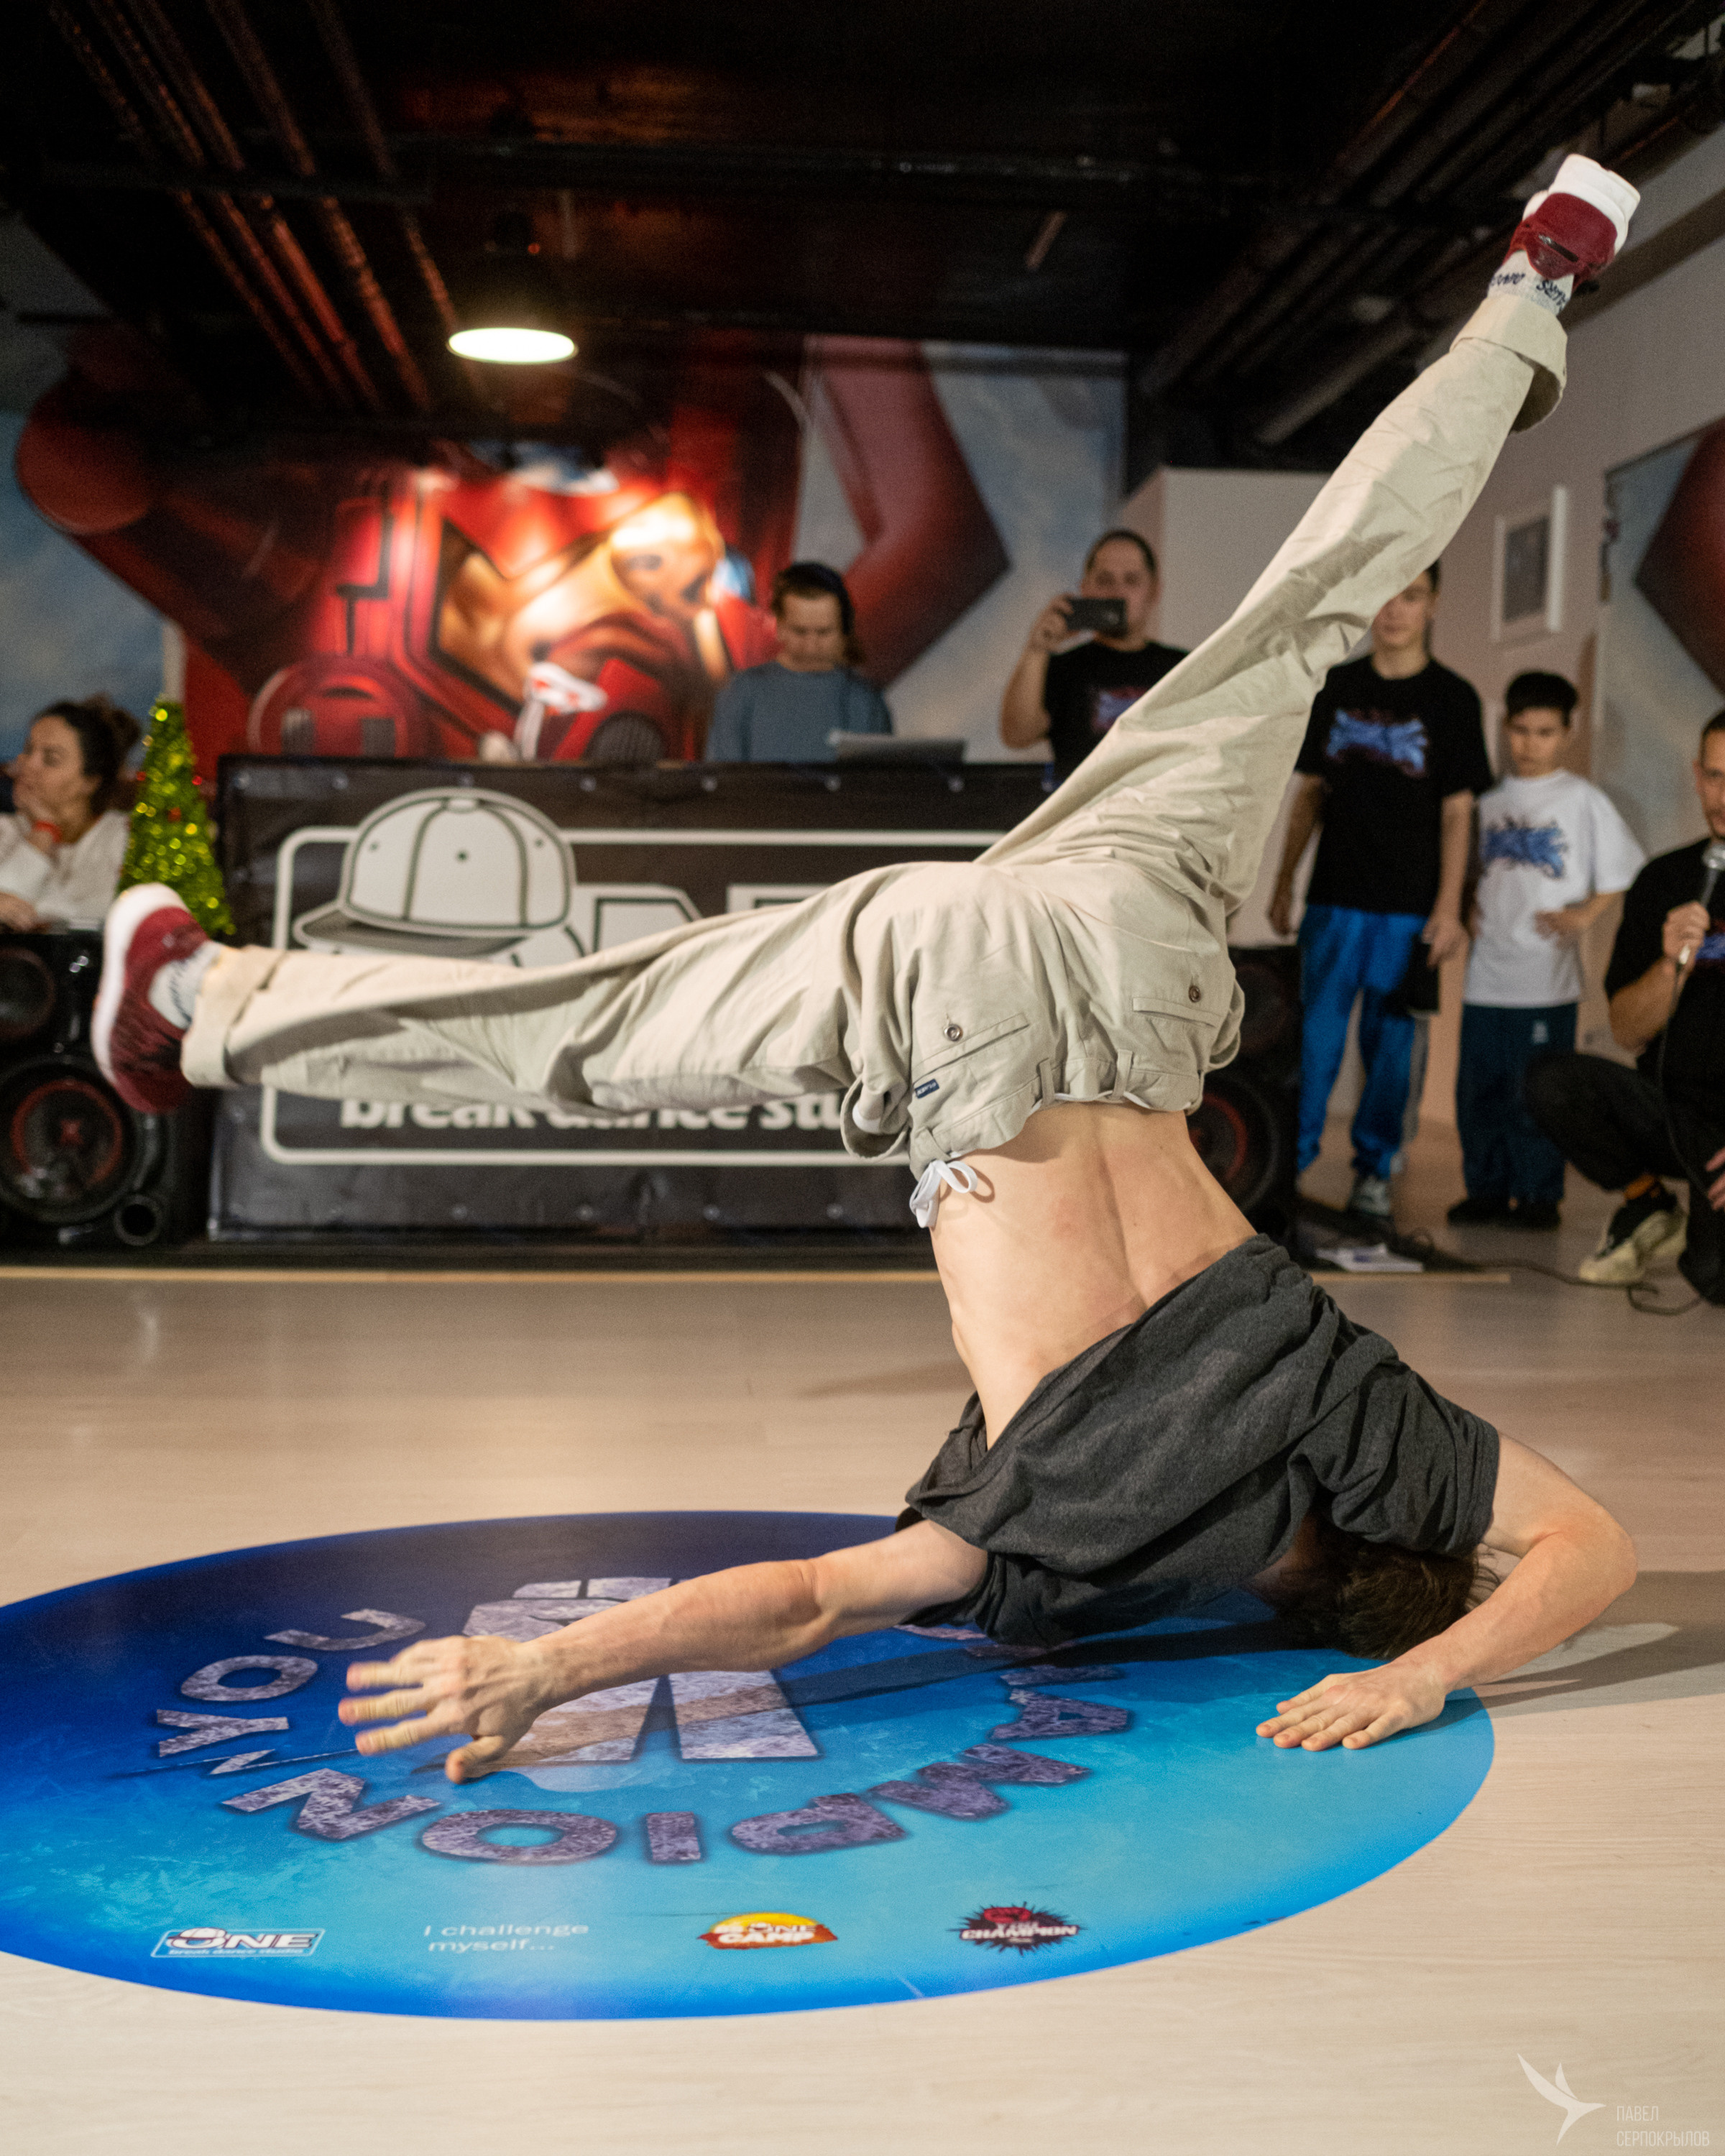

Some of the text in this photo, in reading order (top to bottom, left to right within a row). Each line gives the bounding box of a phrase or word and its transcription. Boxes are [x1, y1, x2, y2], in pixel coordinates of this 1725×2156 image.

[156, 1608, 426, 1758] YOU
[221, 1624, 1130, 1864] HAMPION
[424, 1924, 589, 1938] I challenge
[719, 1932, 815, 1943] CAMP
